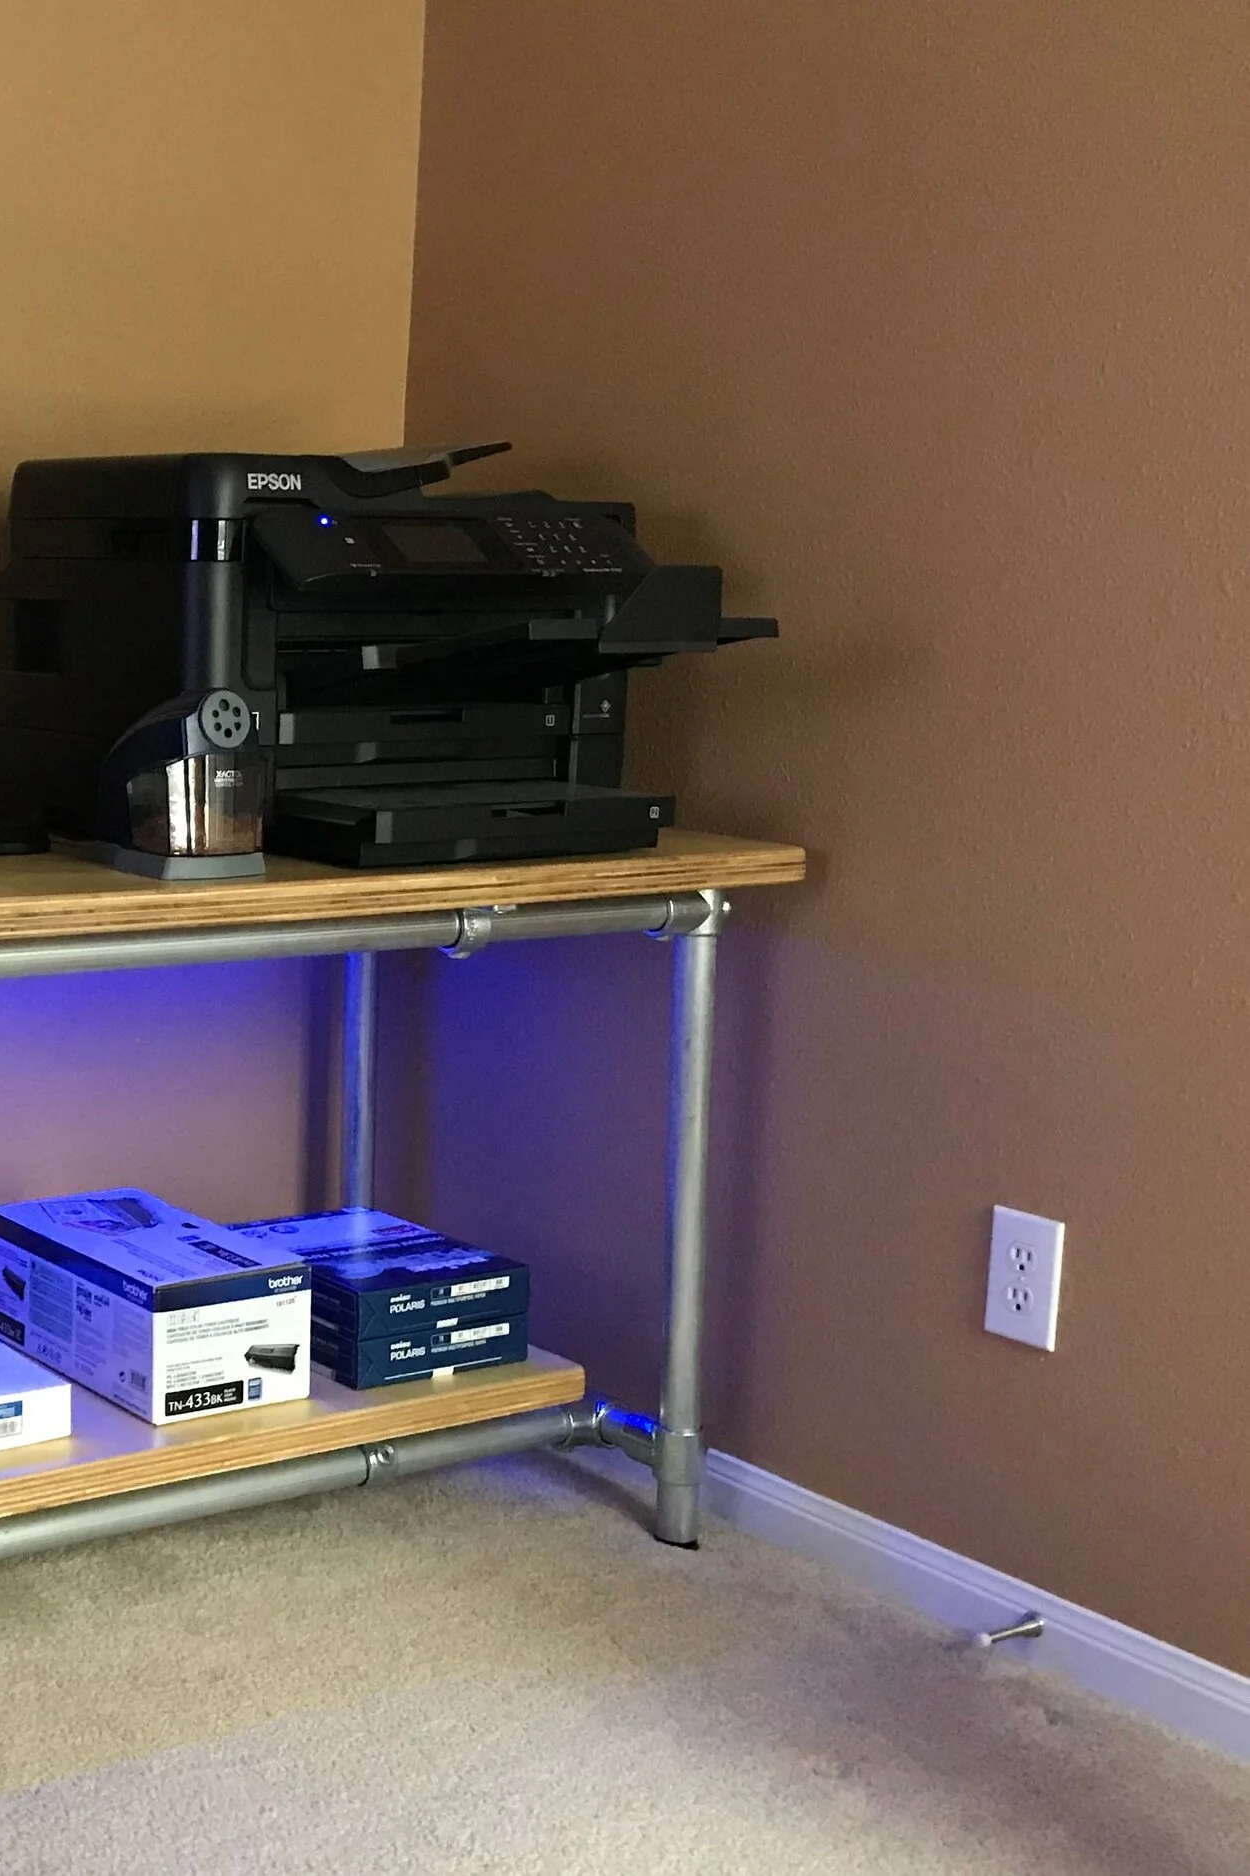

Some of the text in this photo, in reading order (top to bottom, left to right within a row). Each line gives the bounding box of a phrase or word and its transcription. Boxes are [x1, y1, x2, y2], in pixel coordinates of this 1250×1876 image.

[247, 473, 302, 491] EPSON
[268, 1274, 304, 1290] brother
[389, 1299, 426, 1314] POLARIS
[390, 1346, 427, 1361] POLARIS
